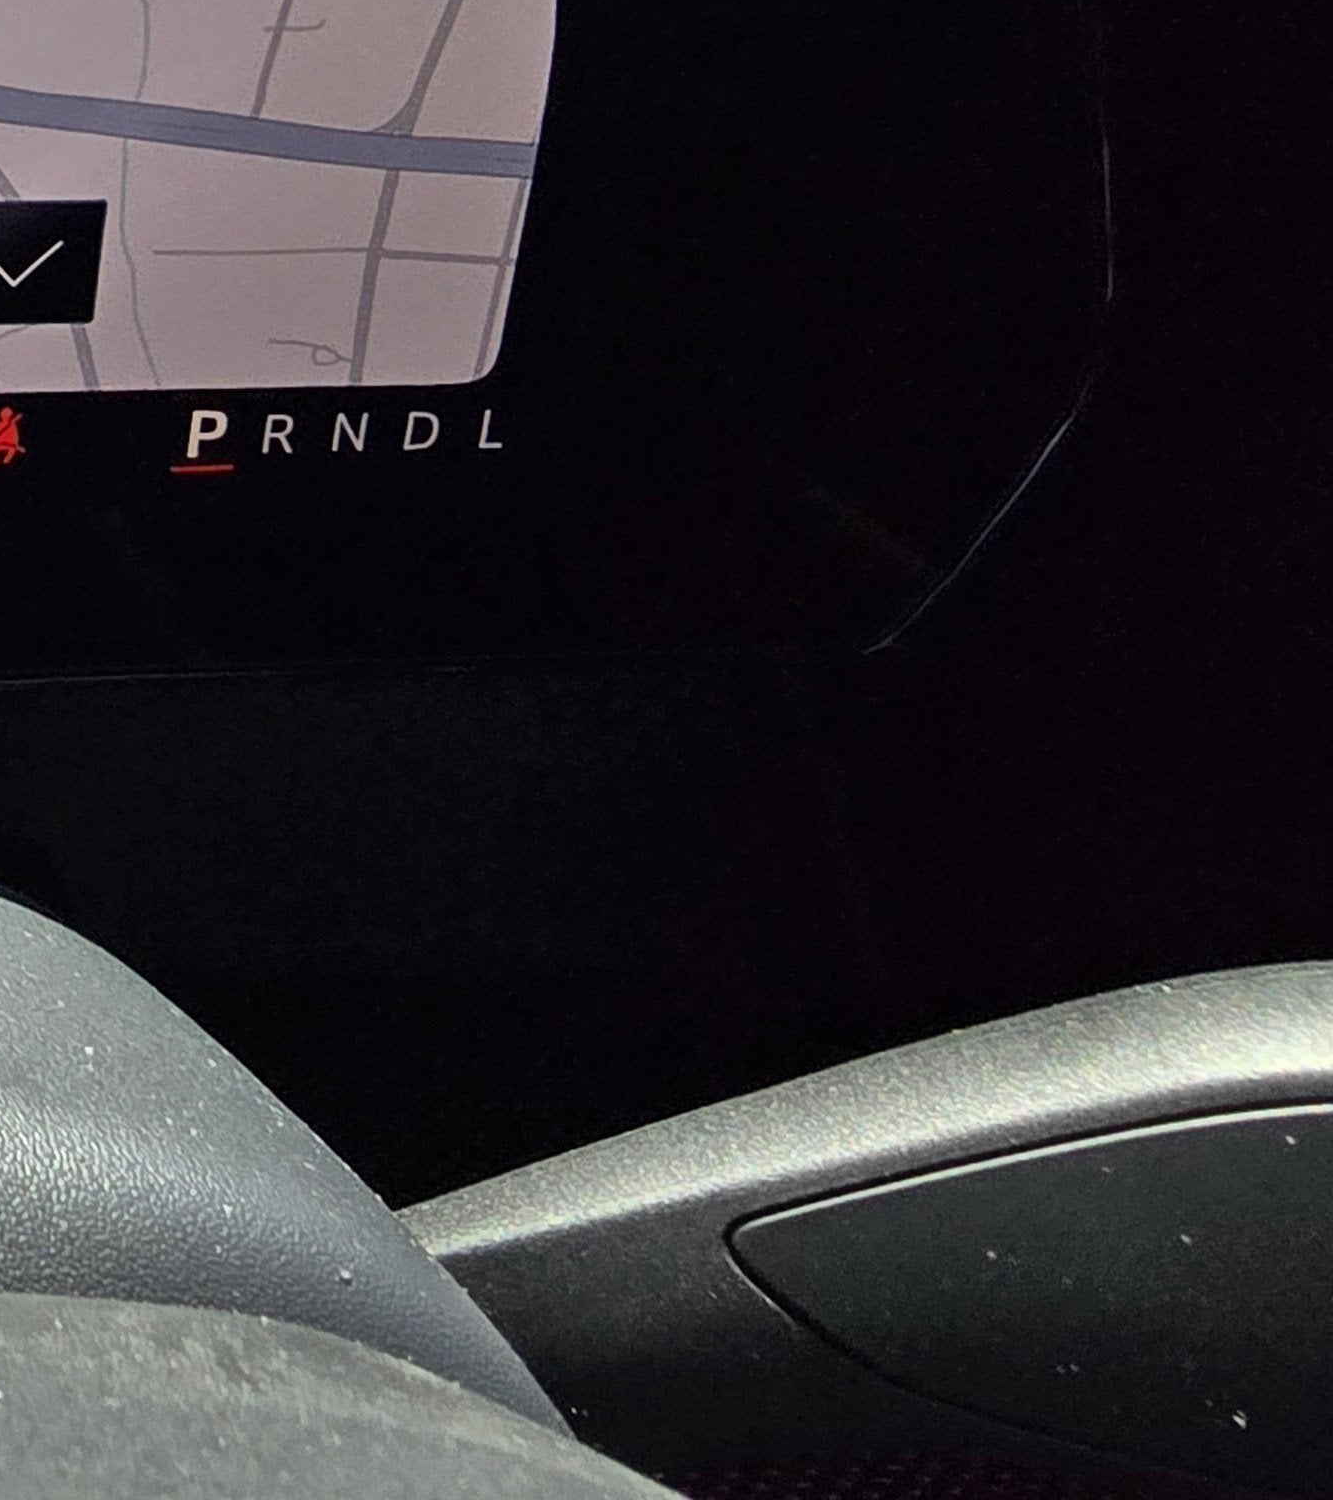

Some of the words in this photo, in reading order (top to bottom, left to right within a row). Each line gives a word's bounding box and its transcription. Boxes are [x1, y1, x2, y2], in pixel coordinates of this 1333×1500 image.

[186, 409, 228, 459] P
[261, 413, 295, 454] R
[331, 412, 370, 452] N
[402, 411, 440, 451] D
[478, 408, 504, 449] L
